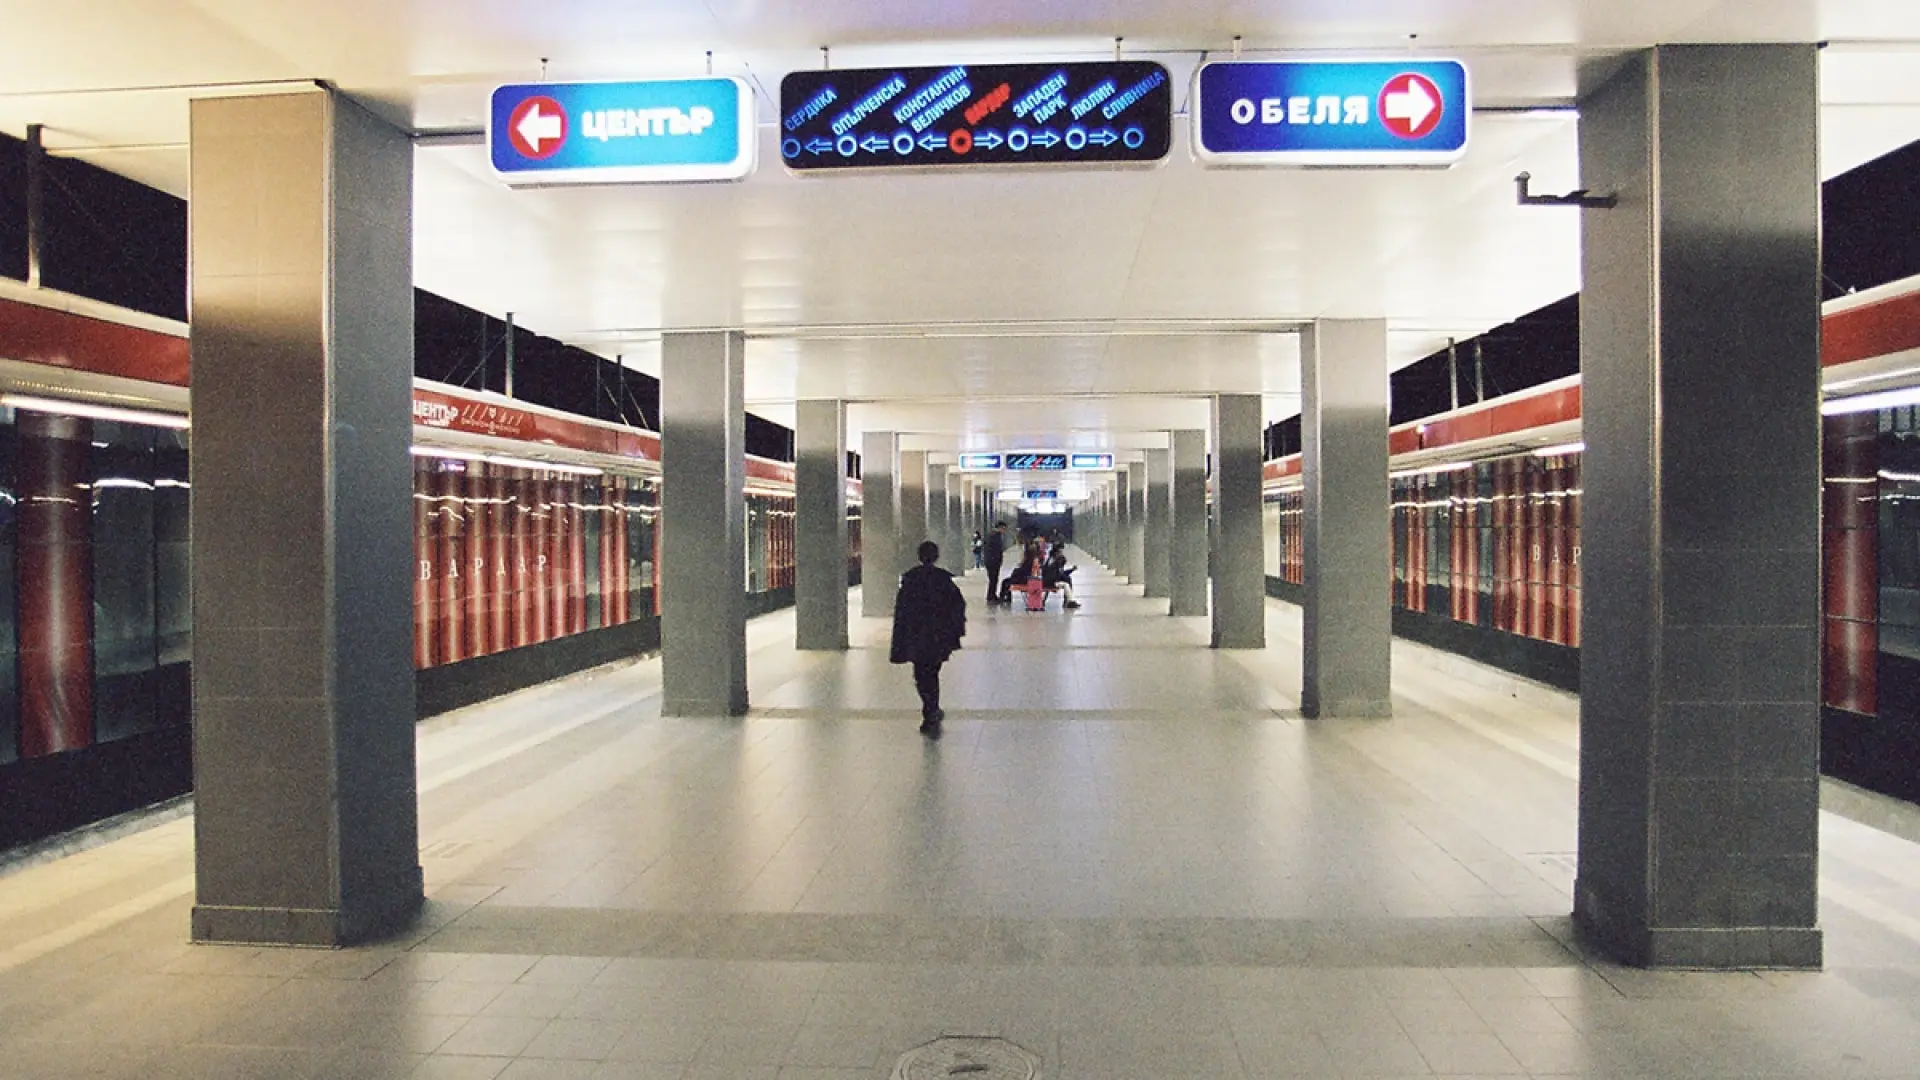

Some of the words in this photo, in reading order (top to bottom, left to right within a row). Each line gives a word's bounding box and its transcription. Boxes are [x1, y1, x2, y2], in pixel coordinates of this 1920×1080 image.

[893, 65, 968, 124] КОНСТАНТИН
[911, 84, 972, 133] ВЕЛИЧКОВ
[1012, 73, 1068, 118] ЗАПАДЕН
[1032, 95, 1068, 124] ПАРК
[1070, 81, 1116, 120] ЛЮЛИН
[1230, 95, 1369, 125] ОБЕЛЯ
[581, 107, 714, 142] ЦЕНТЪР
